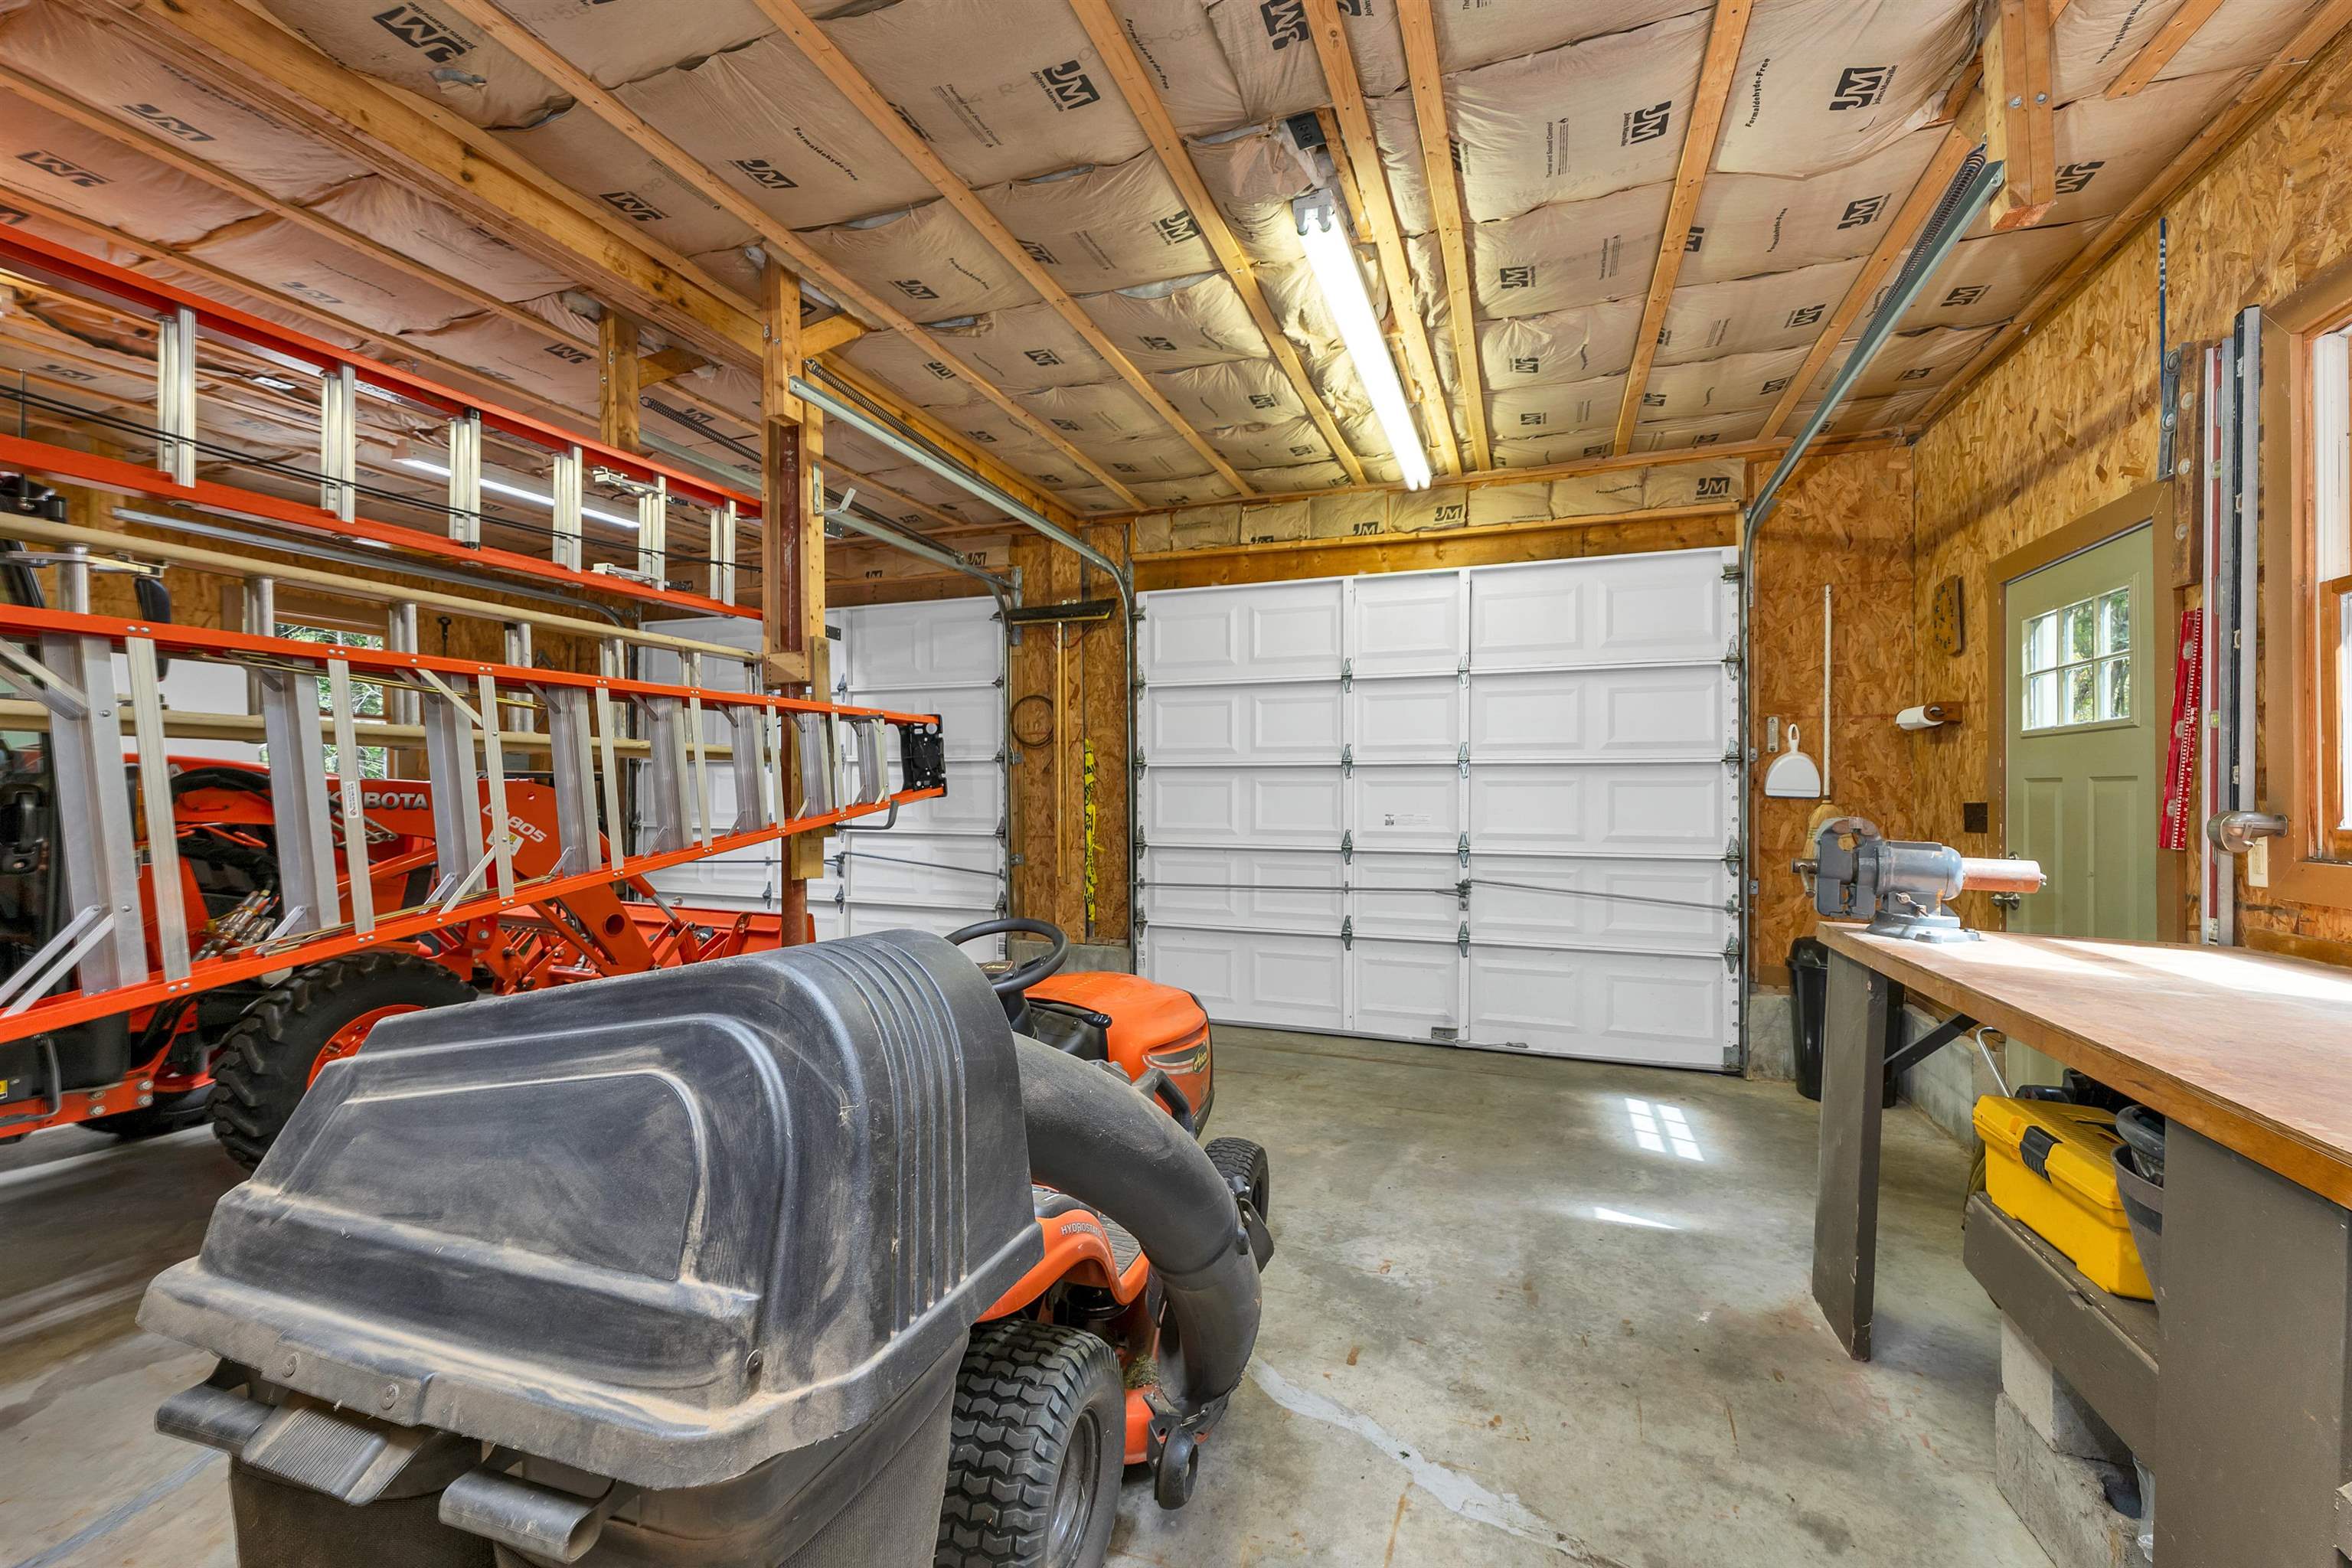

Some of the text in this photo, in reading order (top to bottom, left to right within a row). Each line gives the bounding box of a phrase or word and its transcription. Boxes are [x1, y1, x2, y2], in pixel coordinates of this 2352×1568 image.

[373, 6, 467, 63] JM
[1260, 0, 1309, 51] JM
[1125, 18, 1170, 90] Formaldehyde-Free
[1031, 70, 1064, 113] Johns Manville
[1042, 60, 1100, 109] JM
[1746, 58, 1770, 128] Formaldehyde-Free
[1829, 67, 1886, 110] JM
[1873, 64, 1899, 105] Johns Manville
[121, 103, 217, 142] JM
[946, 83, 966, 106] Thermal
[972, 113, 988, 131] Sound
[986, 129, 1004, 145] Control
[1630, 100, 1671, 145] JM
[15, 152, 113, 187] JM
[793, 126, 858, 181] Formaldehyde-Free
[730, 159, 799, 188] JM
[599, 192, 663, 221] JM
[1838, 195, 1883, 230] JM
[1160, 209, 1201, 244] JM
[894, 280, 939, 299] JM
[1500, 266, 1528, 289] JM
[1940, 286, 1984, 306] JM
[1791, 304, 1827, 328] JM
[544, 343, 592, 364] JM
[1024, 350, 1059, 366] JM
[1515, 358, 1539, 374] JM
[1696, 477, 1730, 495] JM
[1353, 521, 1383, 536] JM
[1434, 504, 1463, 522] JM
[967, 552, 986, 566] JM
[328, 791, 429, 809] KBOTA
[482, 803, 547, 843] L805
